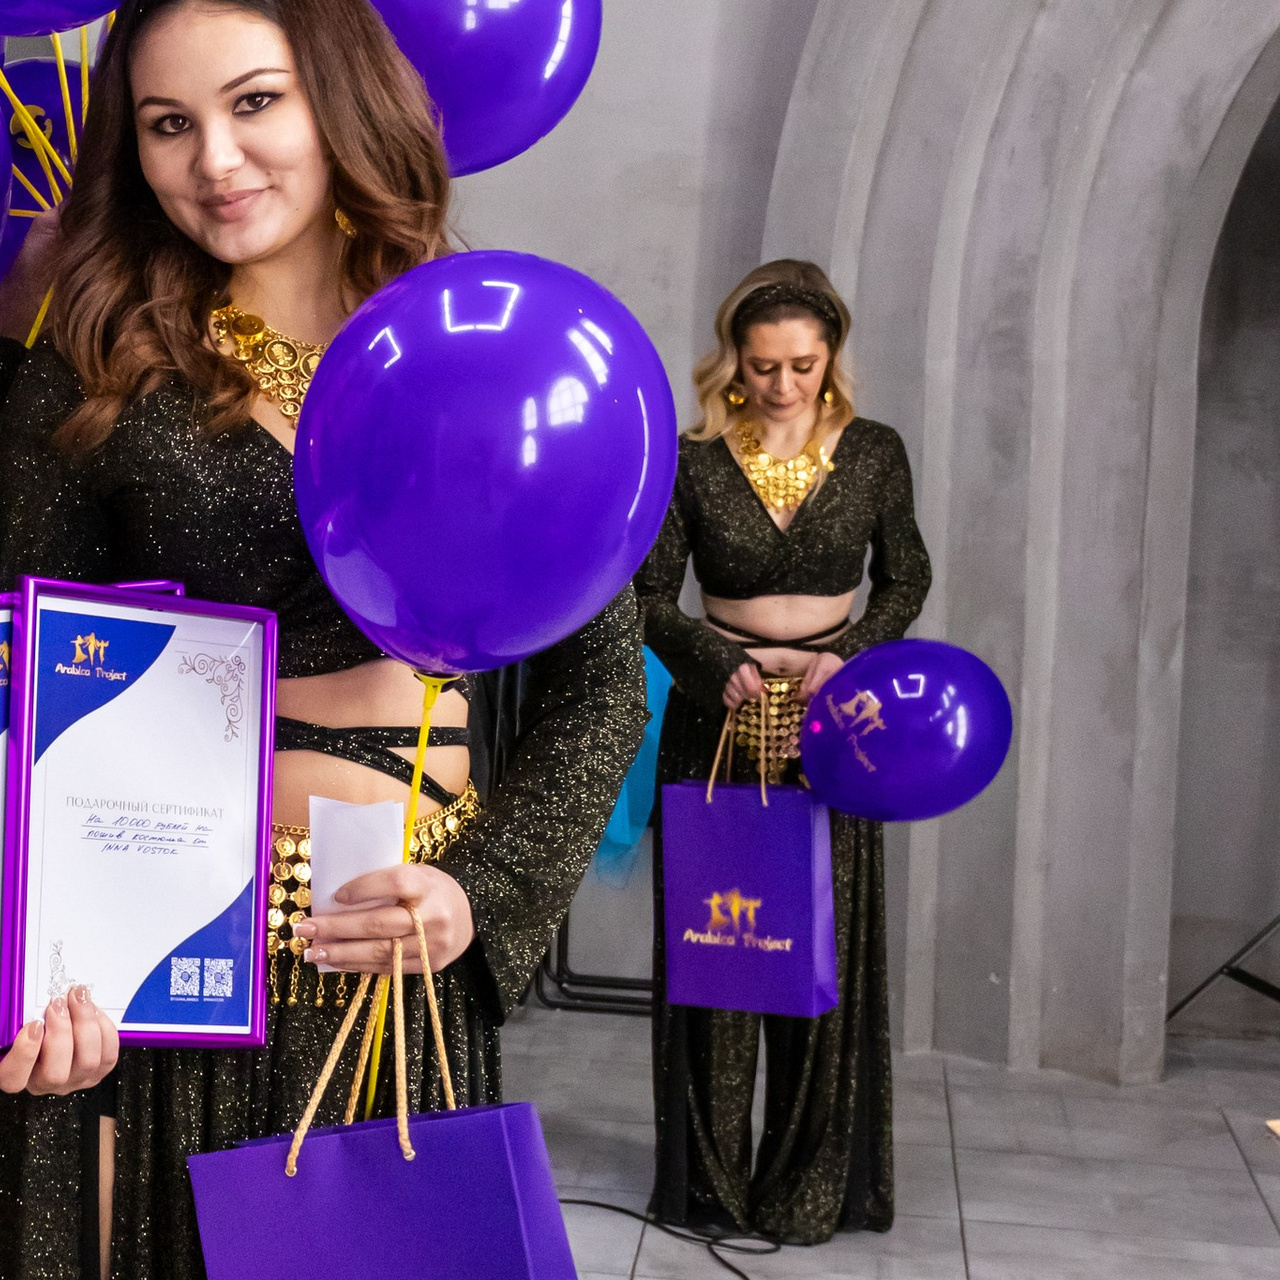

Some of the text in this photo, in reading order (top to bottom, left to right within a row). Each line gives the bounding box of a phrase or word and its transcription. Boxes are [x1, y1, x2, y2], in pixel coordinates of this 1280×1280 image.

[55, 662, 128, 682] Arabica Project
[66, 796, 224, 819] ПОДАРОЧНЫЙ СЕРТИФИКАТ
[100, 842, 179, 856] INNA VOSTOK
